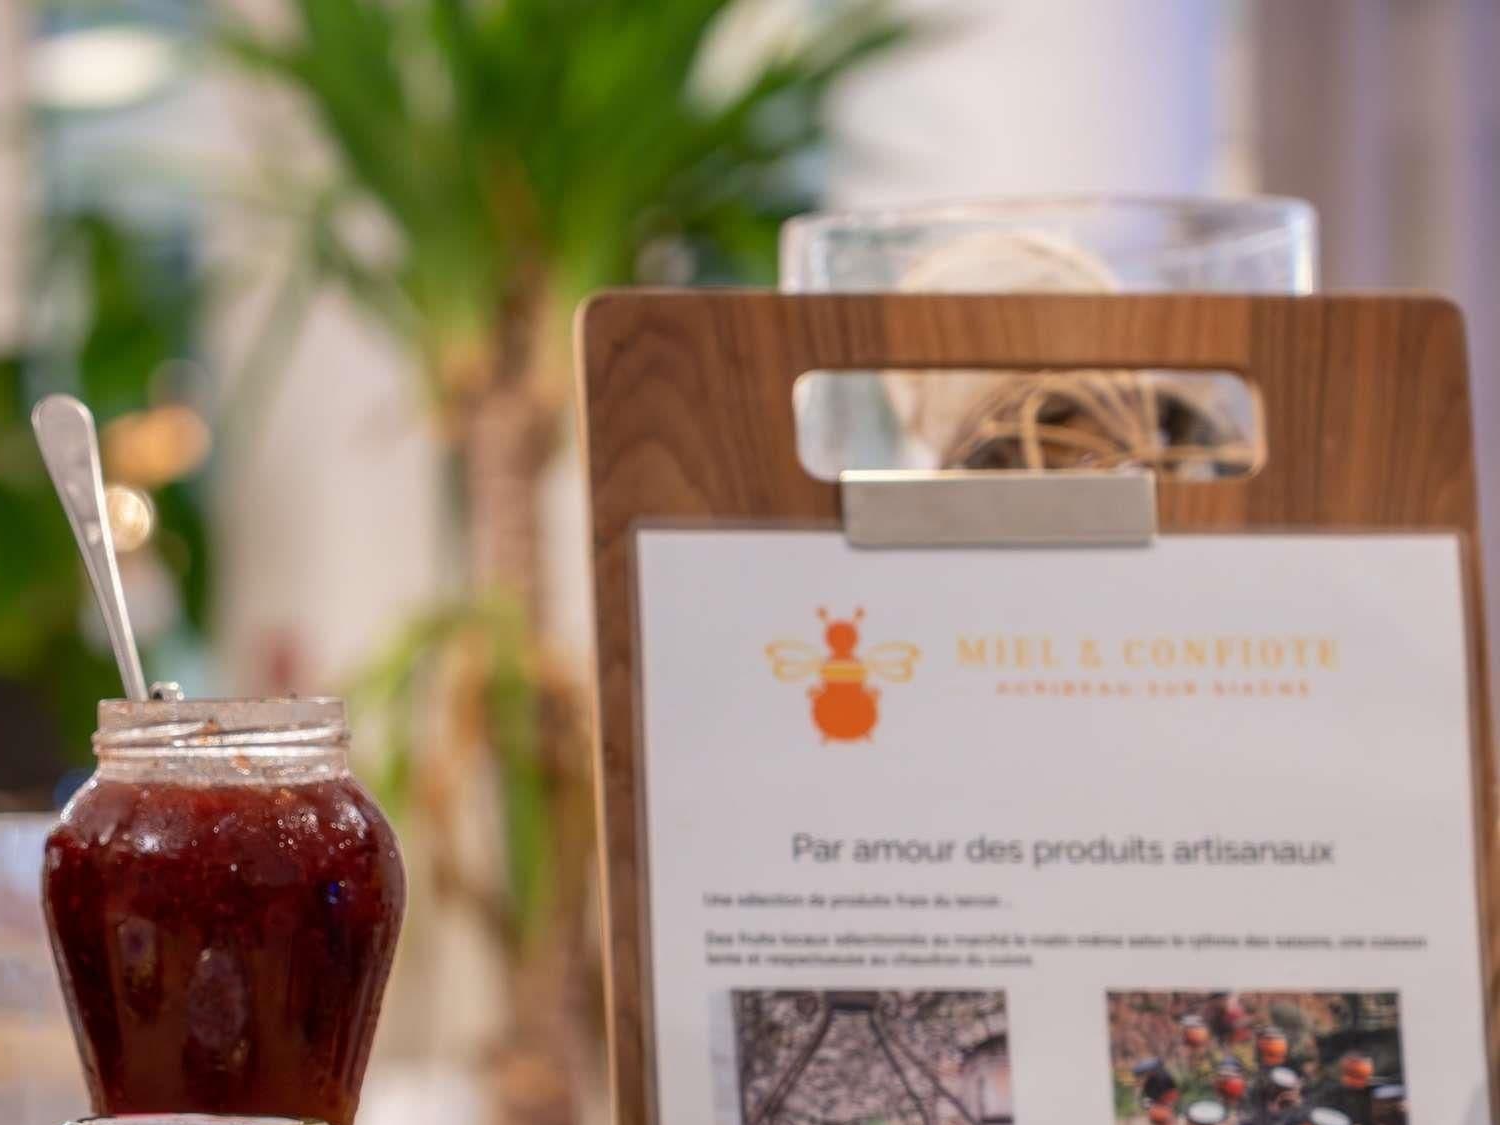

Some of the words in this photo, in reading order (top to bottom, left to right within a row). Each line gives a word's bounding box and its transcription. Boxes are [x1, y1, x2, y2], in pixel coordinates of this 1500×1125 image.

[957, 638, 1061, 668] MIEL
[791, 833, 843, 862] Par
[852, 840, 956, 863] amour
[964, 835, 1025, 863] des
[1033, 834, 1164, 871] produits
[1173, 837, 1336, 864] artisanaux
